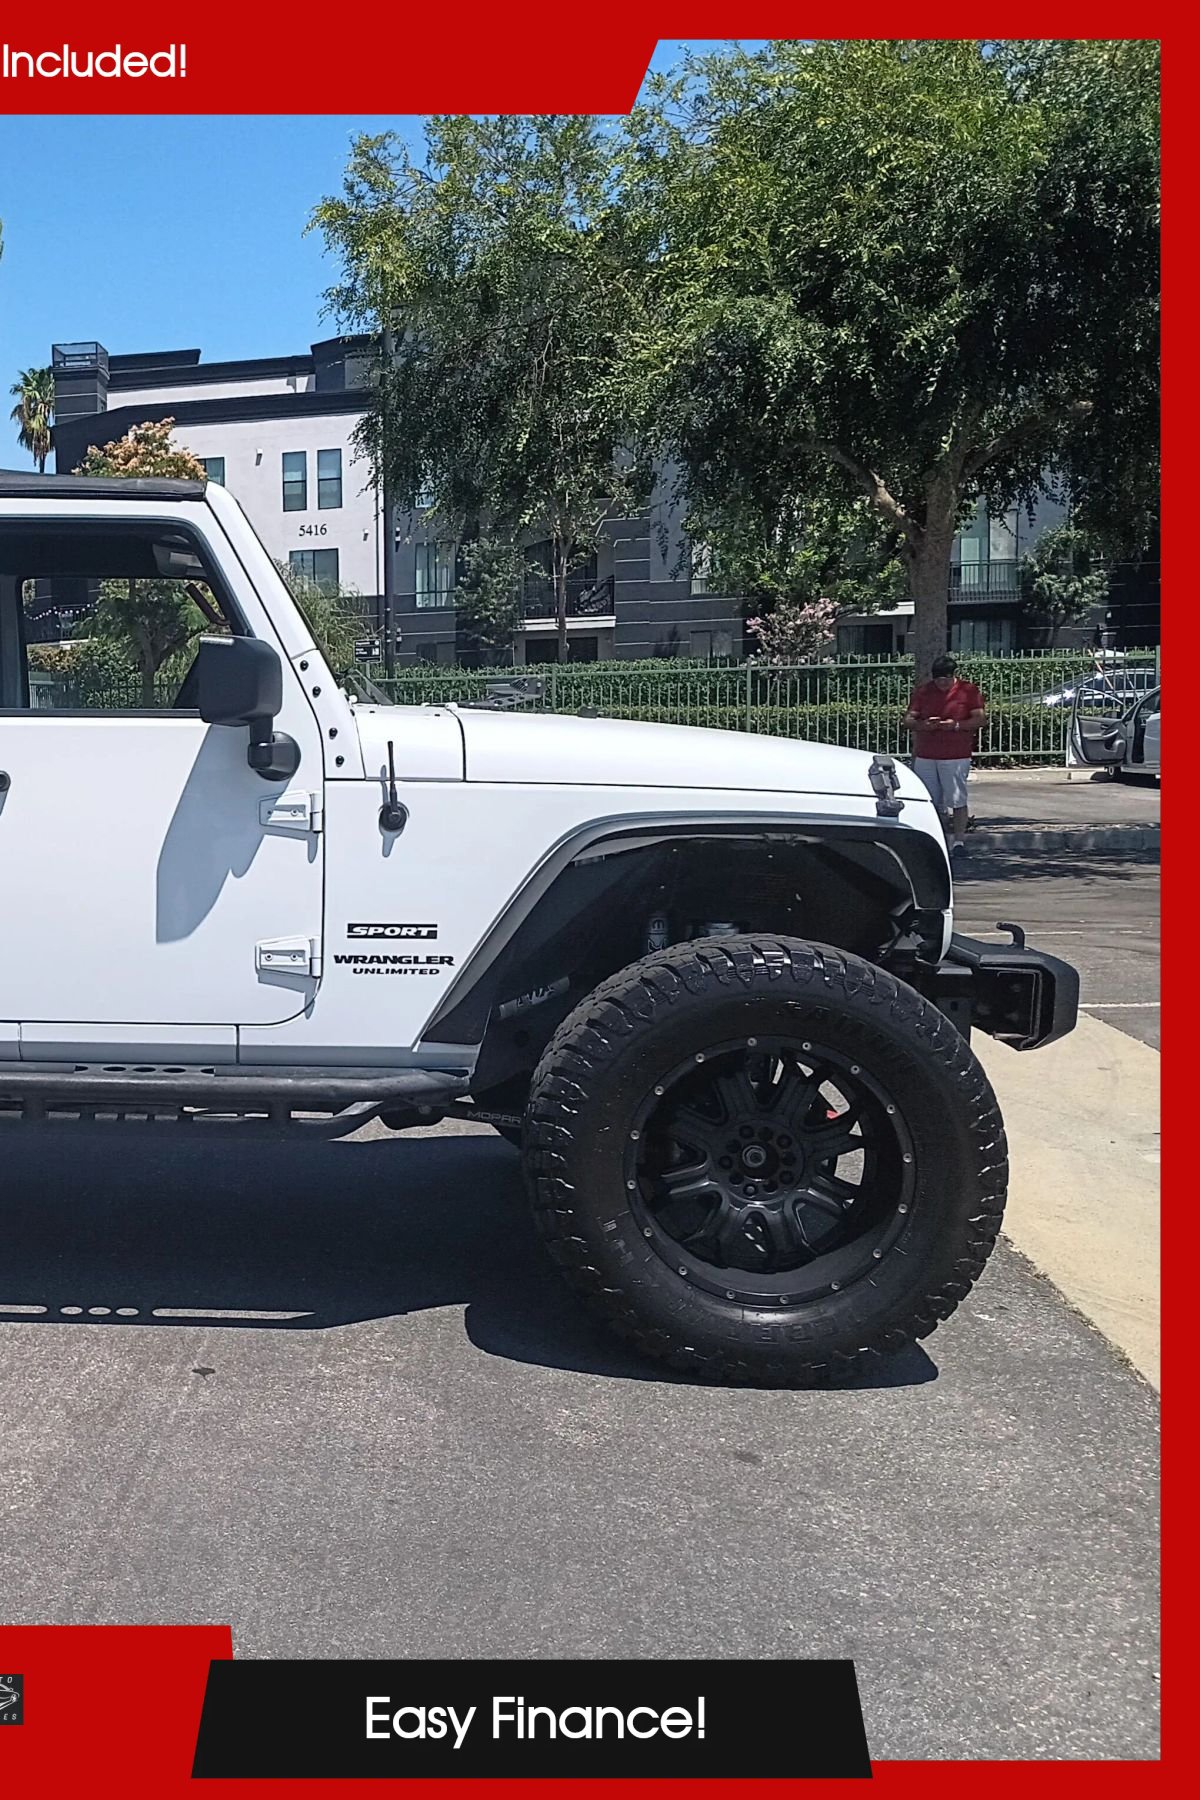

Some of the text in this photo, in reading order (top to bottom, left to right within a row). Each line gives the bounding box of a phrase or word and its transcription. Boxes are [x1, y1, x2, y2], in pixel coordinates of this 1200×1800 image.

[298, 523, 328, 537] 5416
[348, 925, 437, 938] SPORT
[333, 954, 455, 966] WRANGLER
[352, 968, 441, 976] UNLIMITED
[467, 1110, 522, 1125] MOPAR
